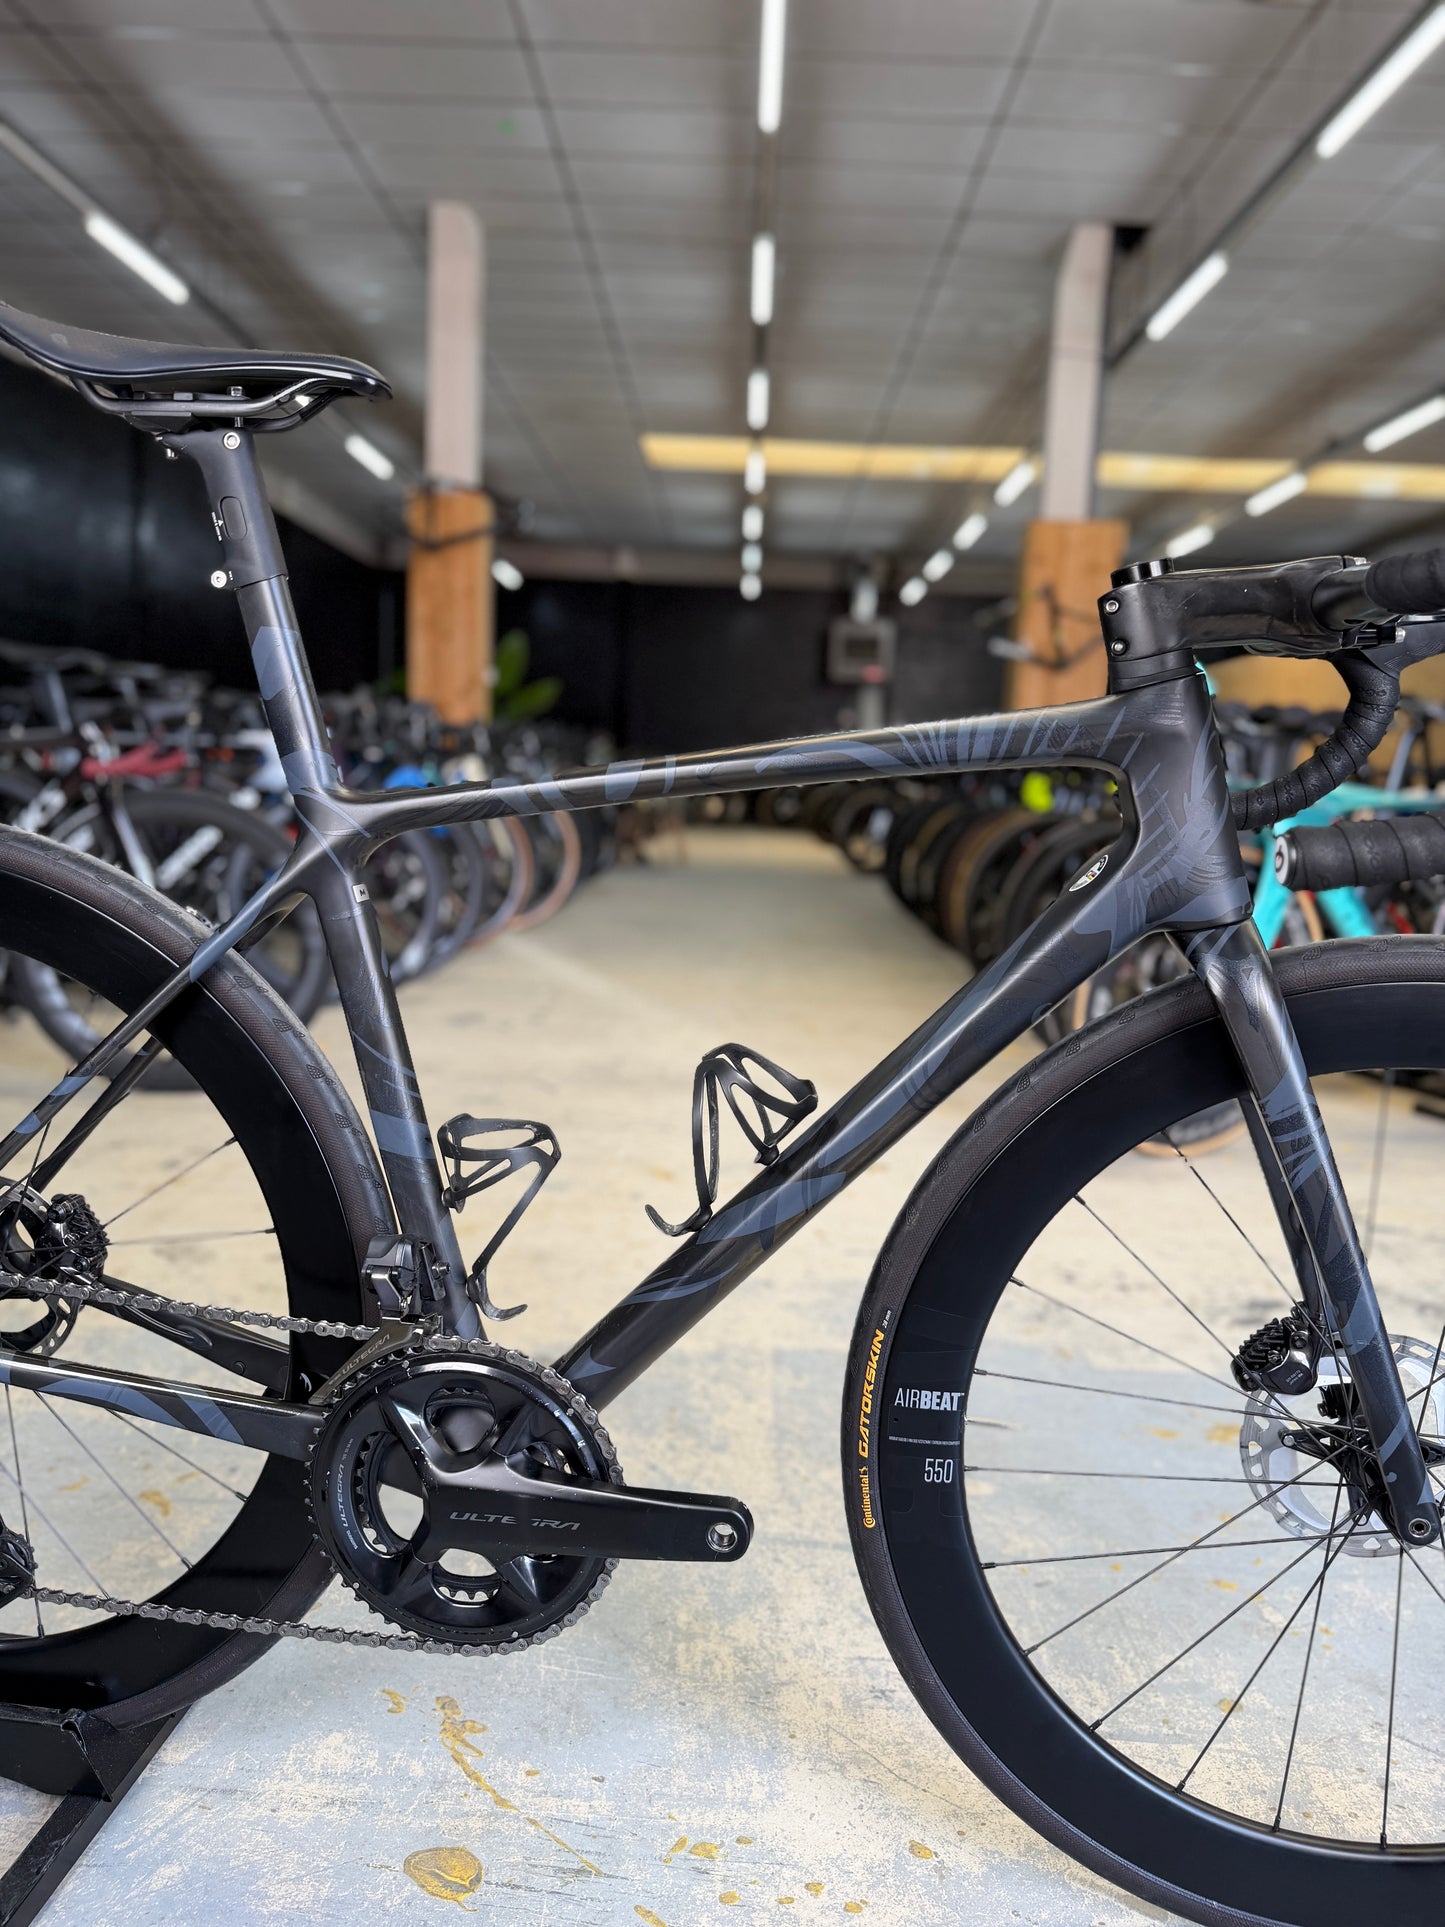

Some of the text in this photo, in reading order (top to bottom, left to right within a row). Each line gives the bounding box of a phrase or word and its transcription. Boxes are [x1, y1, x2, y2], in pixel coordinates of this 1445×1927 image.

[341, 1332, 391, 1375] ULTEGRA
[858, 1328, 885, 1459] GATORSKIN
[894, 1387, 961, 1412] AIRBEAT
[337, 1463, 349, 1528] ULTEGRA
[924, 1458, 954, 1484] 550
[860, 1473, 876, 1529] Continental
